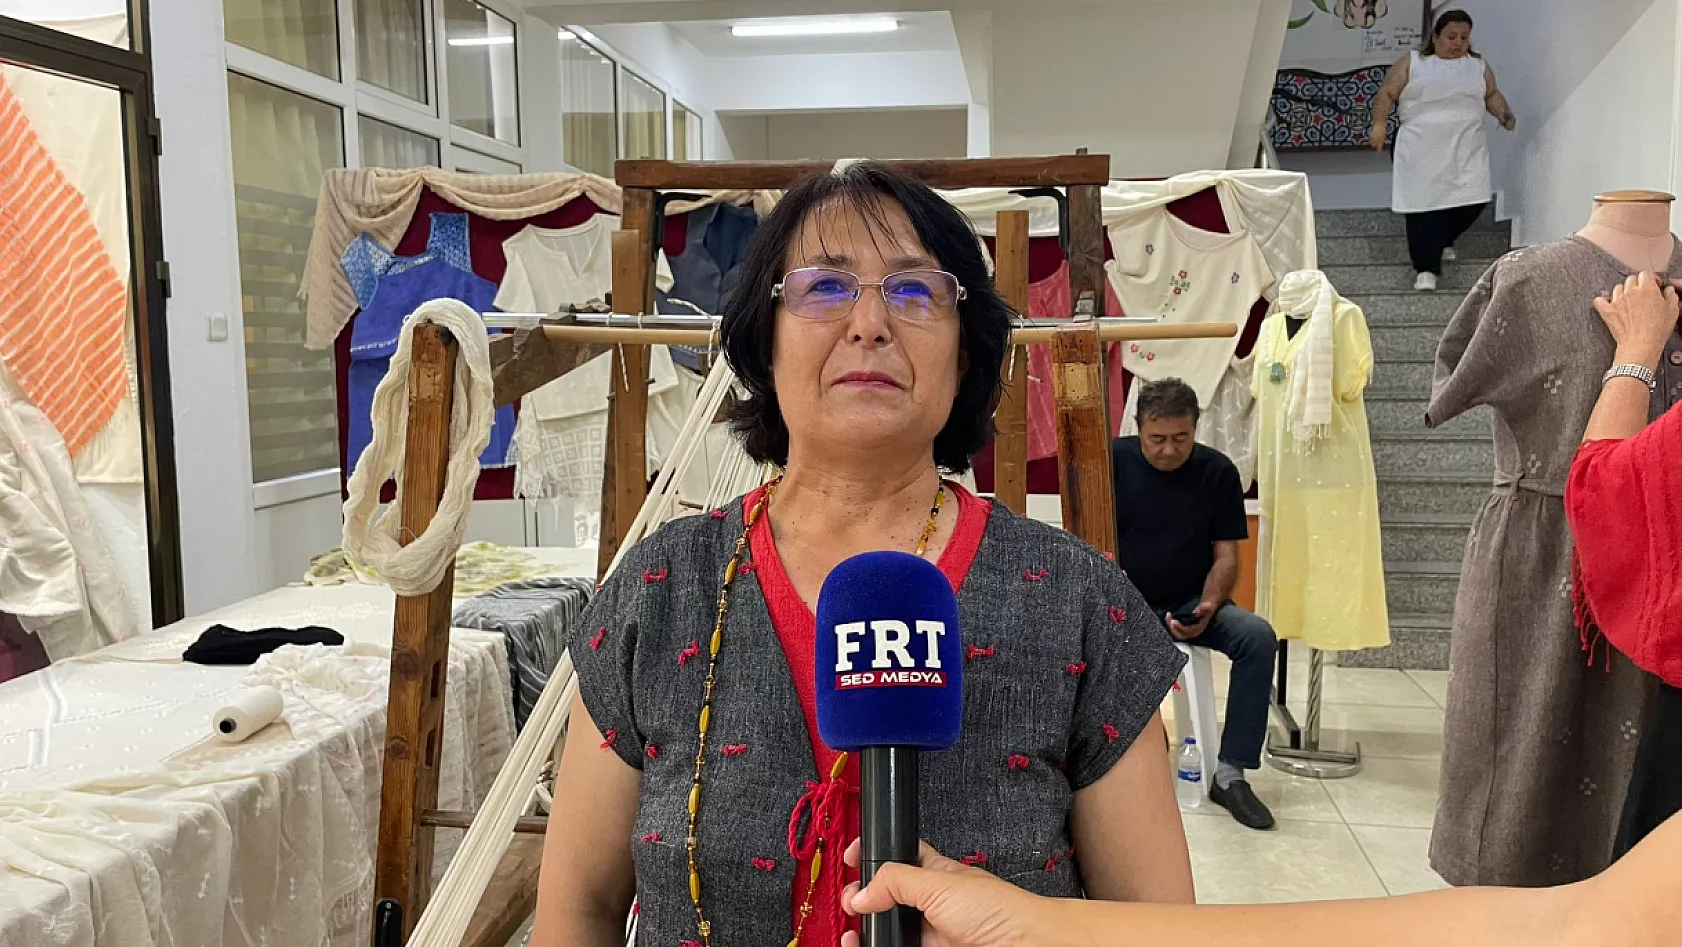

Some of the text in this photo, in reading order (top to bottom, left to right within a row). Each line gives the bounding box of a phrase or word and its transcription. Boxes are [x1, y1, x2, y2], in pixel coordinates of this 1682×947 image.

[834, 619, 946, 672] FRT
[840, 671, 943, 687] SED MEDYA
